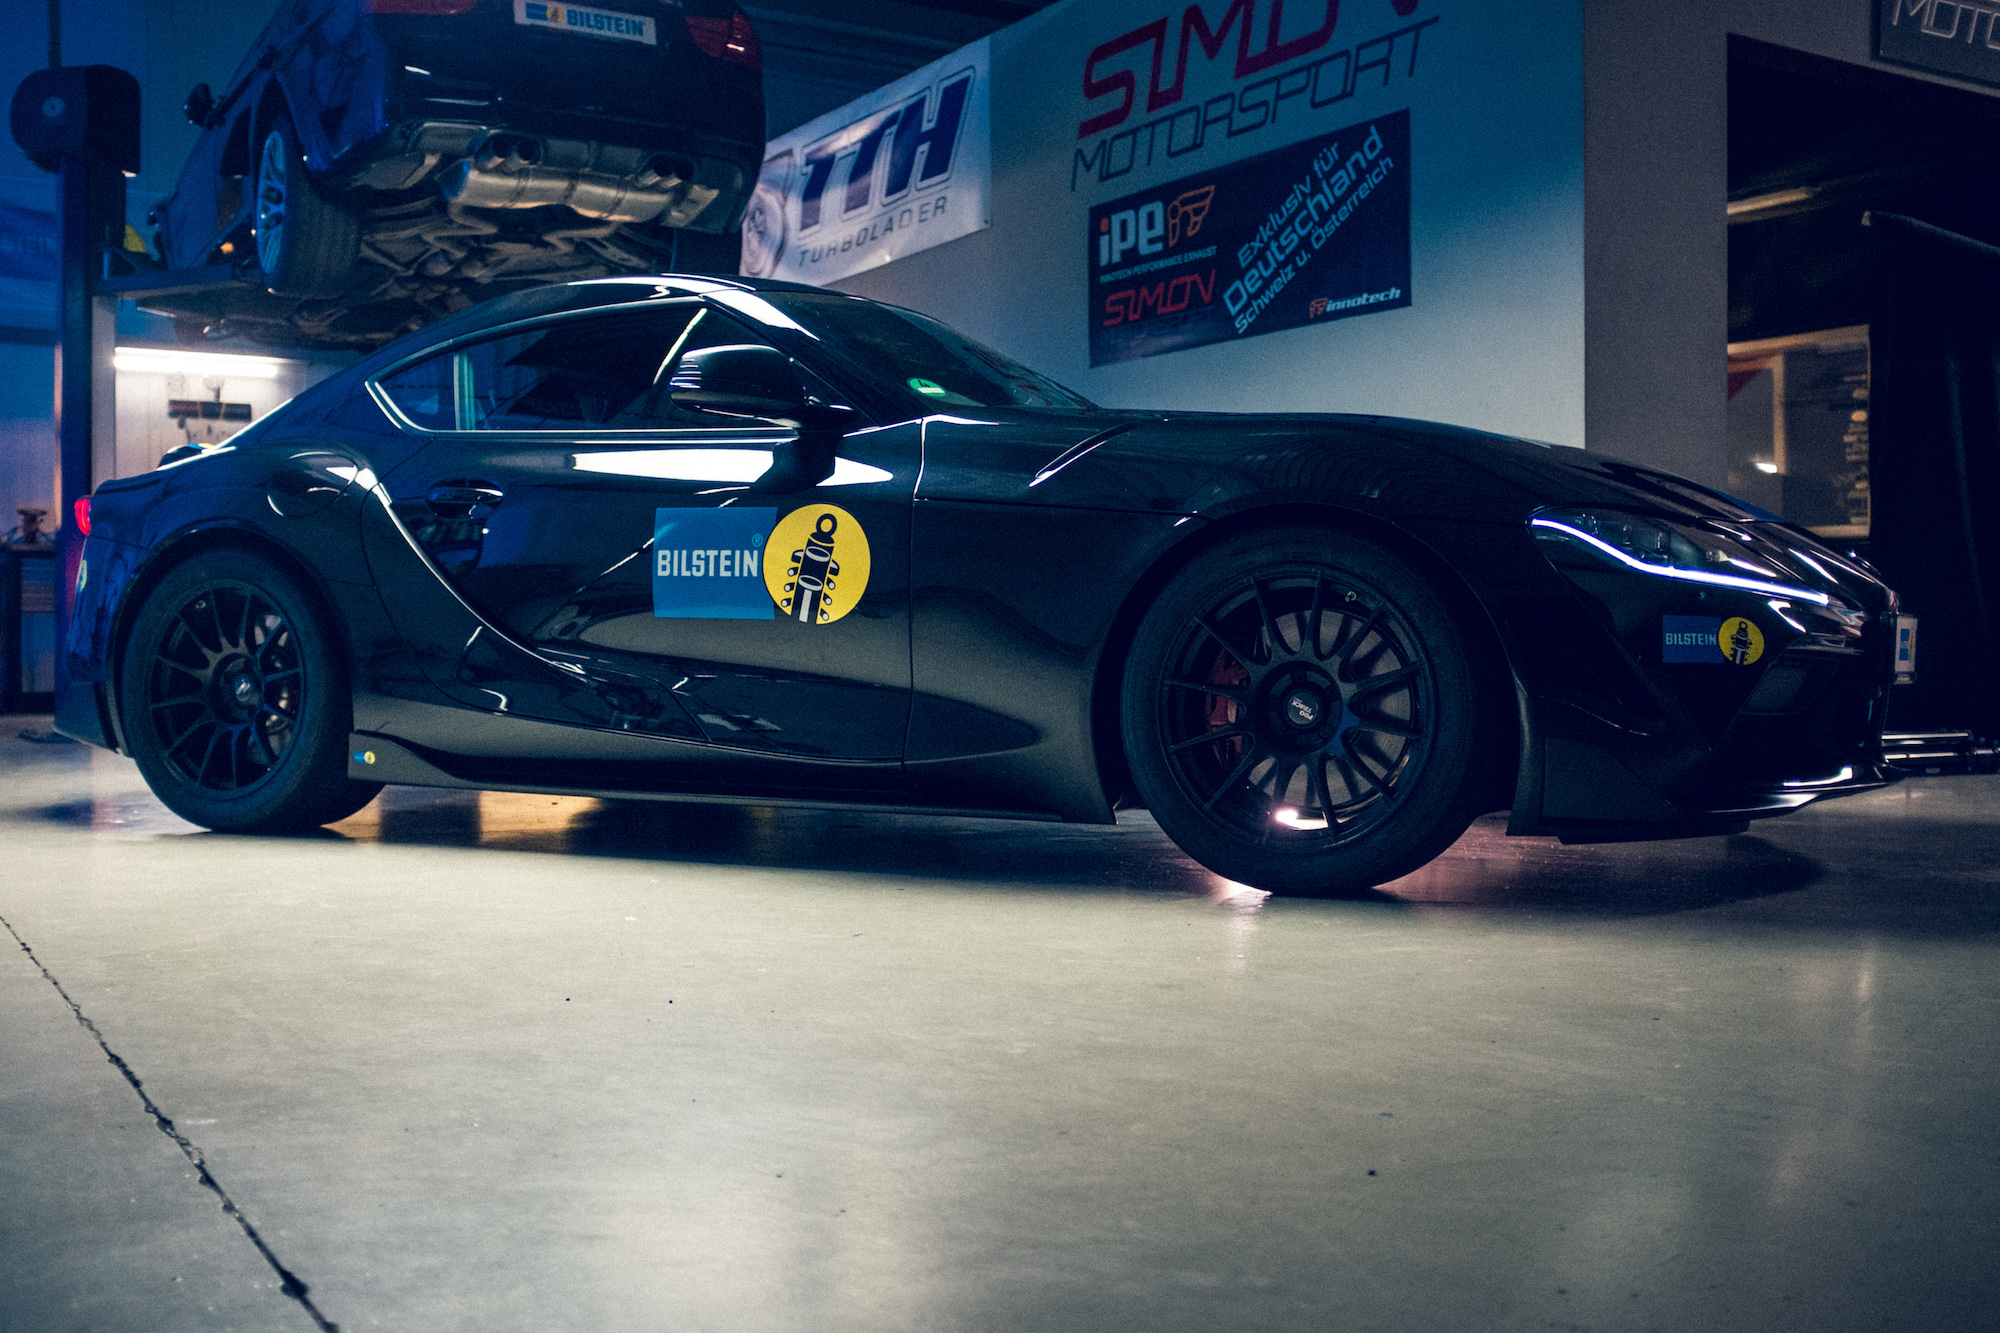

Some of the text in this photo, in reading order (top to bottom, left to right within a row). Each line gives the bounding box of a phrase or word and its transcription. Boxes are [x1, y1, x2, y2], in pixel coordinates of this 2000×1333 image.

[566, 9, 644, 37] BILSTEIN
[1076, 0, 1419, 140] SIMO
[797, 72, 975, 235] TTH
[1070, 15, 1440, 192] MOTORSPORT
[799, 195, 948, 267] TURBOLADER
[1222, 124, 1384, 317] Deutschland
[1234, 155, 1395, 334] Schweiz u. Österreich
[1236, 141, 1341, 270] Exklusiv für
[1102, 269, 1216, 328] SIMOV
[1325, 286, 1401, 312] innotech
[656, 549, 759, 577] BILSTEIN
[1665, 632, 1717, 646] BILSTEIN
